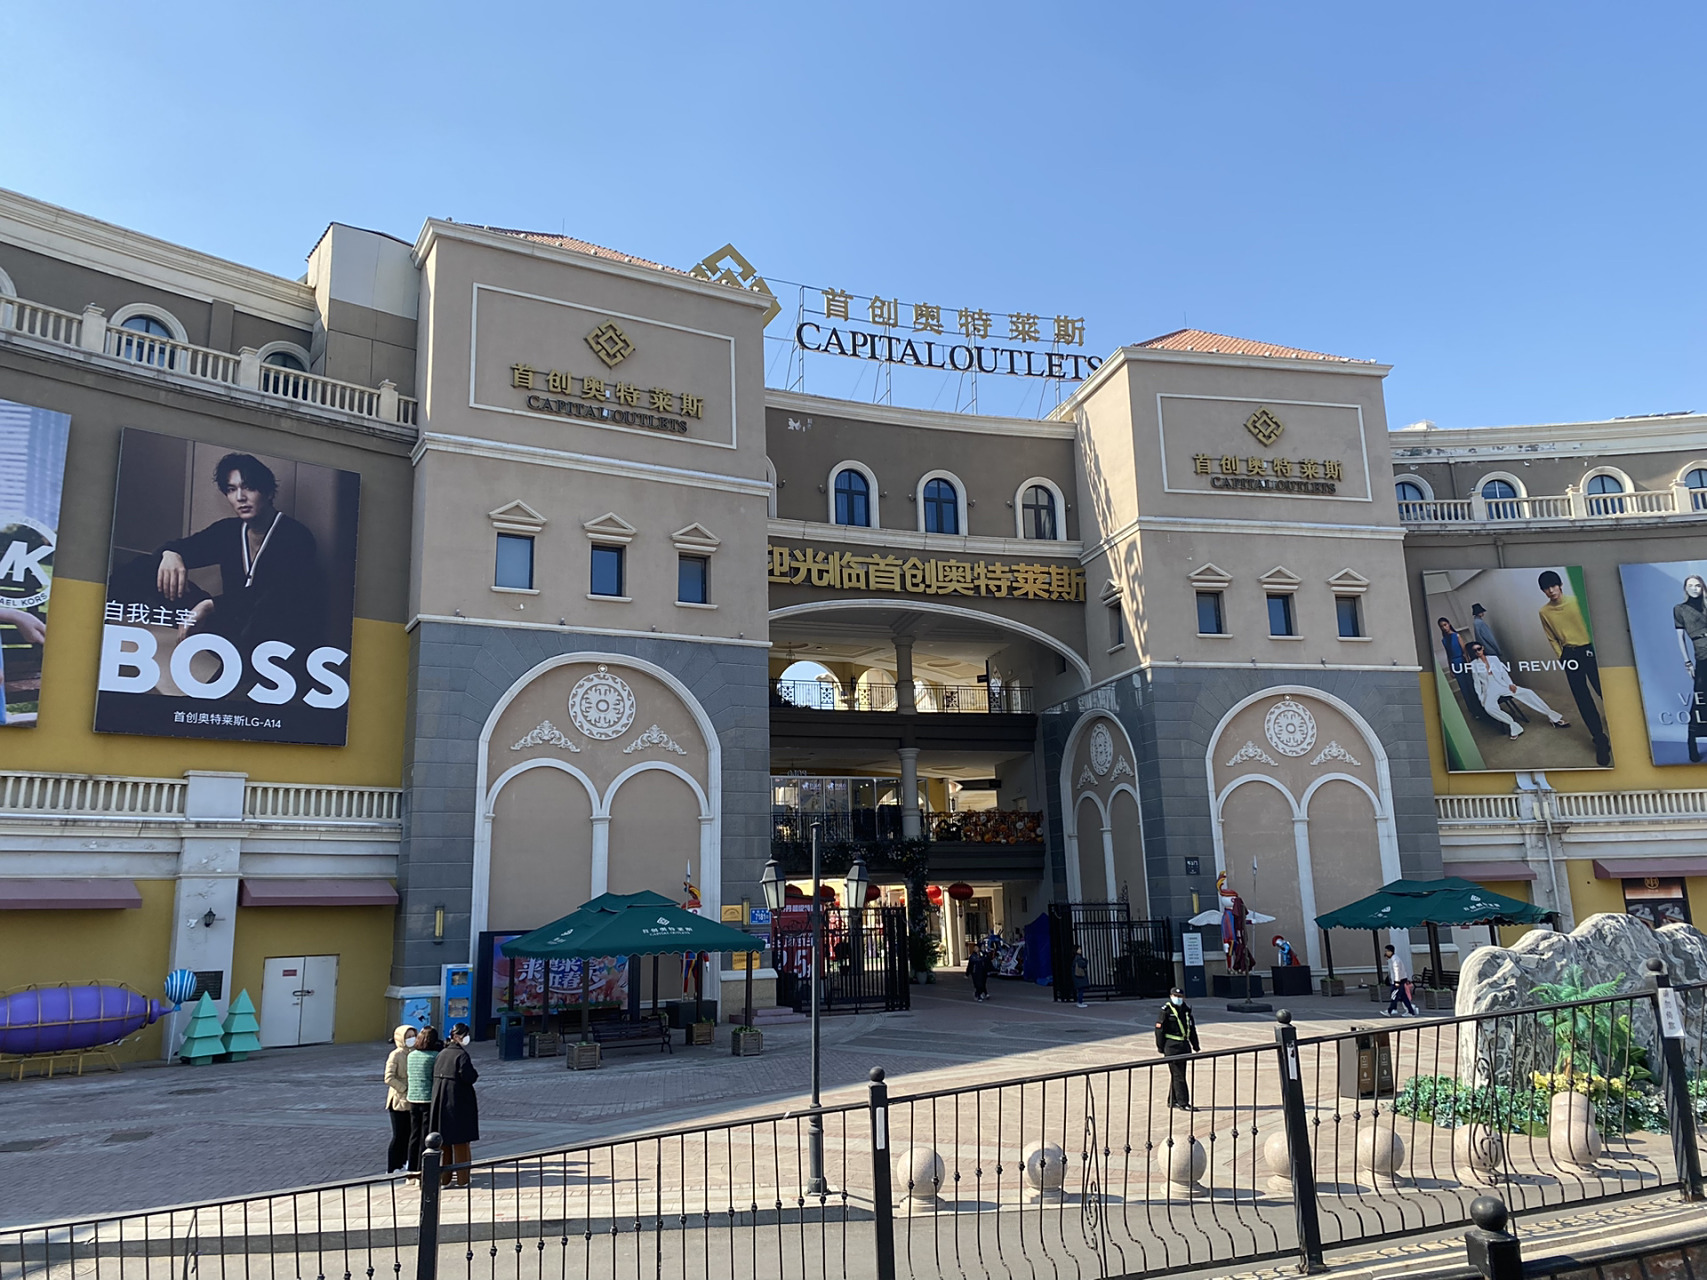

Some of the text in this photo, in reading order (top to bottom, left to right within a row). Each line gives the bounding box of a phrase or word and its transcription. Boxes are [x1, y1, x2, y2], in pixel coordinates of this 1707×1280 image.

[821, 287, 1086, 347] 首创奥特莱斯
[511, 363, 704, 419] 首创奥特莱斯
[1194, 453, 1343, 481] 首创奥特莱斯
[21, 593, 48, 606] KORS
[104, 600, 198, 628] 自我主宰
[98, 623, 350, 709] BOSS
[1518, 659, 1579, 672] REVIVO
